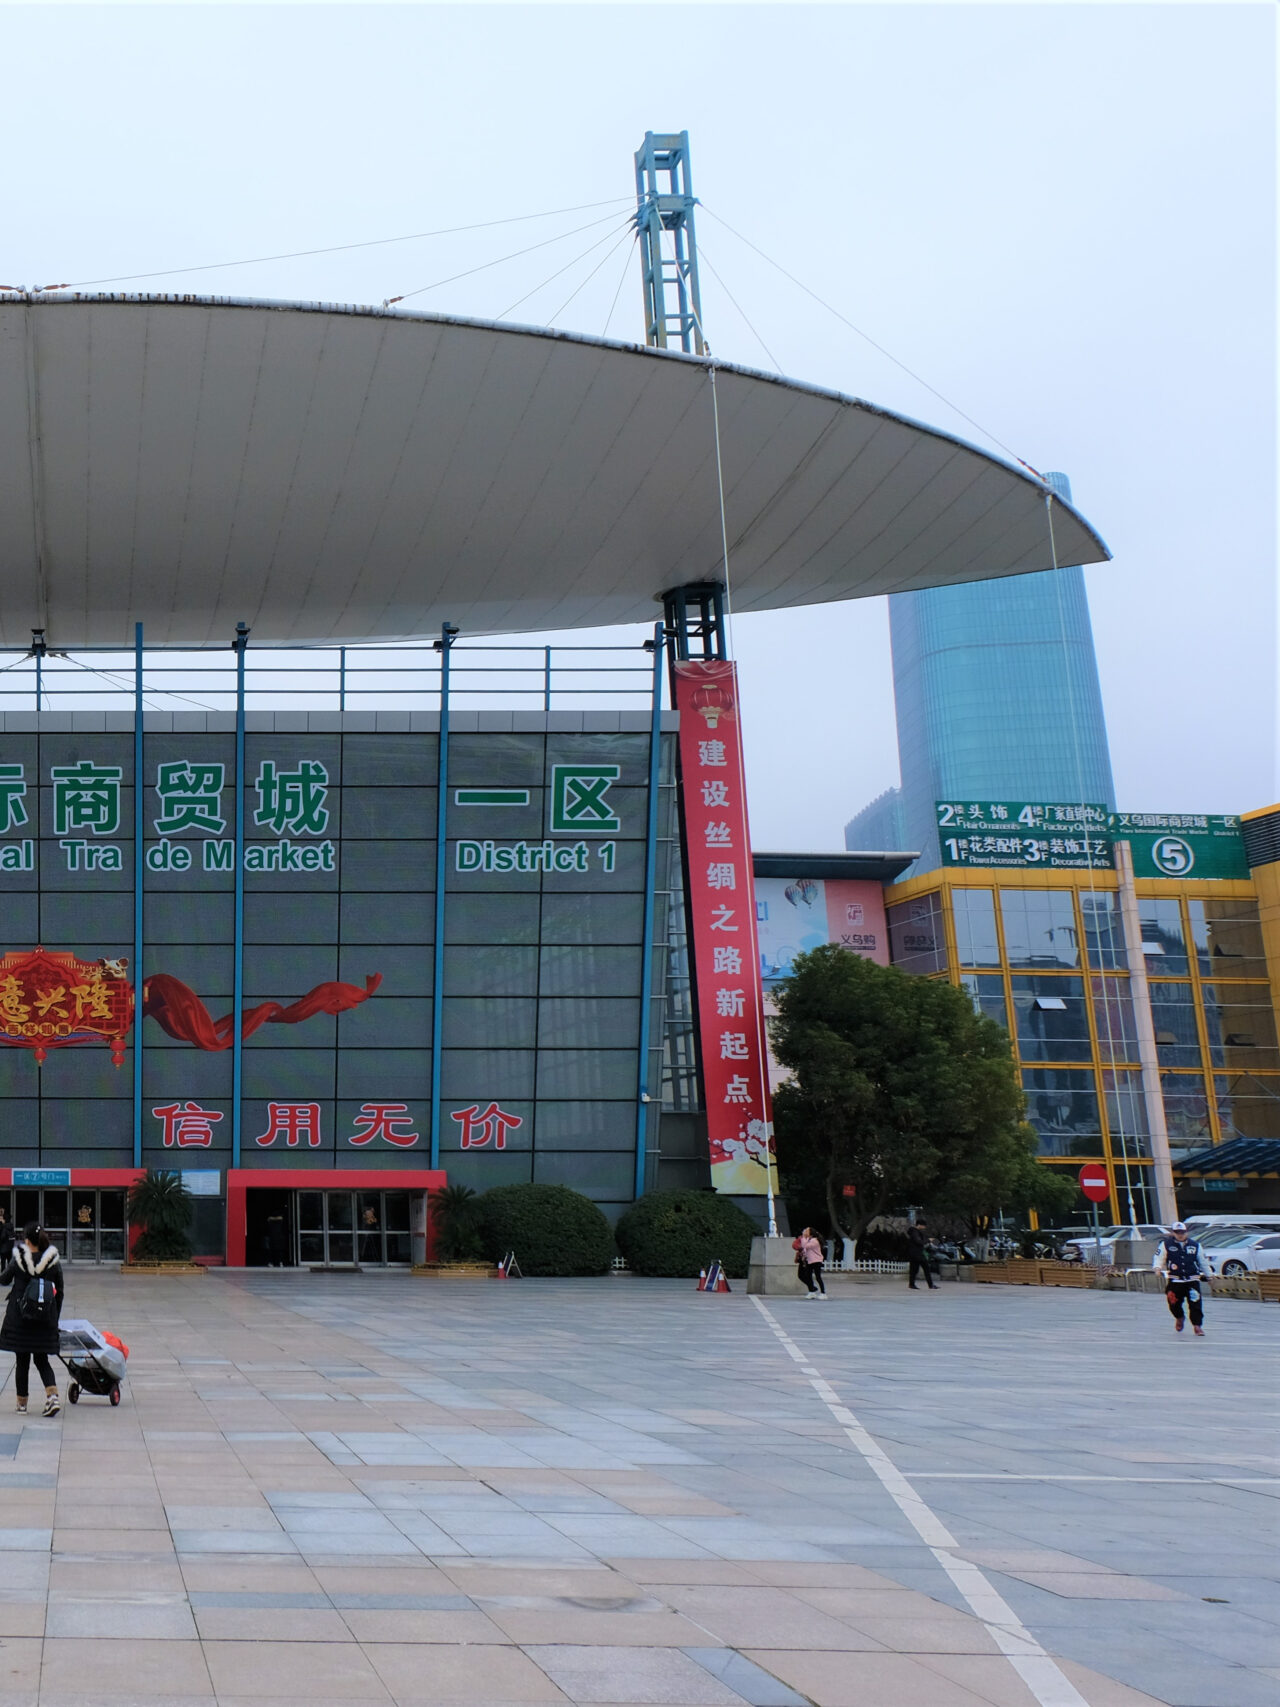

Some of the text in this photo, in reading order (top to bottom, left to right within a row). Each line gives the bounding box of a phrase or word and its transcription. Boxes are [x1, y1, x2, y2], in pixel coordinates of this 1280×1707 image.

[455, 764, 620, 832] 一区
[938, 804, 956, 826] 2
[968, 804, 1008, 820] 头饰
[1018, 805, 1035, 828] 4
[1043, 822, 1074, 832] Factory
[1074, 822, 1106, 831] Outlets
[1119, 814, 1237, 828] 义乌国际商贸城 一区
[456, 840, 588, 871] District
[597, 840, 616, 871] 1
[945, 838, 959, 860] 1
[968, 836, 1024, 853] 花类配件
[1023, 839, 1041, 861] 3
[1050, 838, 1107, 854] 装饰工艺
[698, 739, 752, 1104] 建设丝绸之路新起点
[841, 934, 876, 946] 义乌购
[152, 1101, 523, 1150] 信用无价
